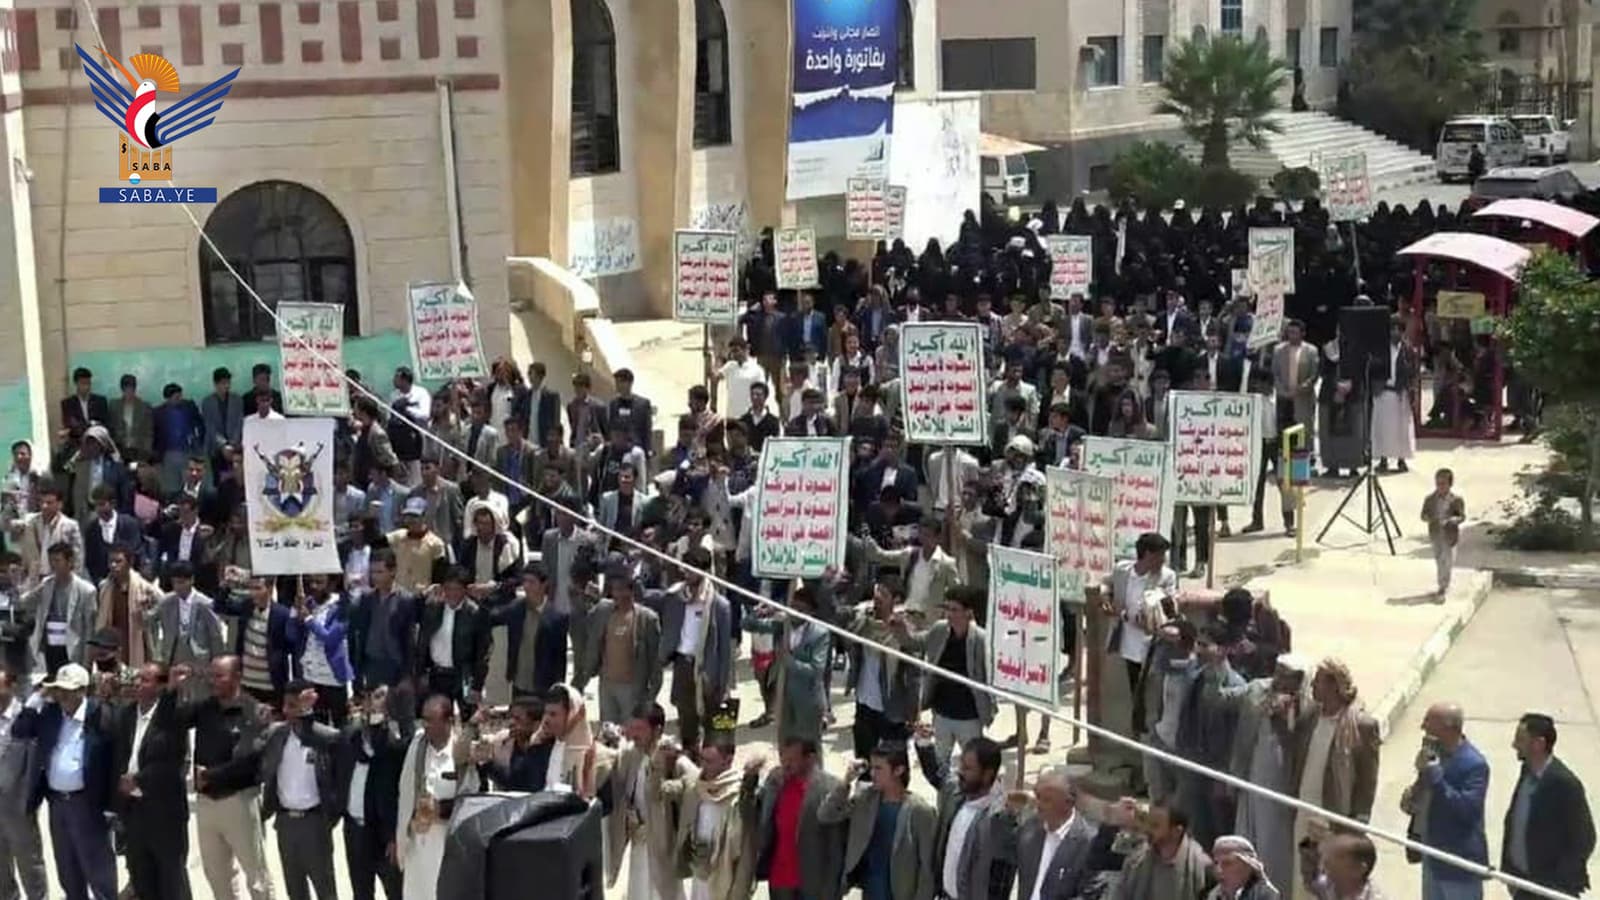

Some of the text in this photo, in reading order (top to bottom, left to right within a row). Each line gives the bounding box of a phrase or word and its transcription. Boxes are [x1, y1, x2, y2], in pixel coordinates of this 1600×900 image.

[805, 47, 886, 75] بفاتورة واحدة
[949, 333, 975, 352] الله
[1224, 400, 1250, 416] الله
[812, 448, 839, 468] الله
